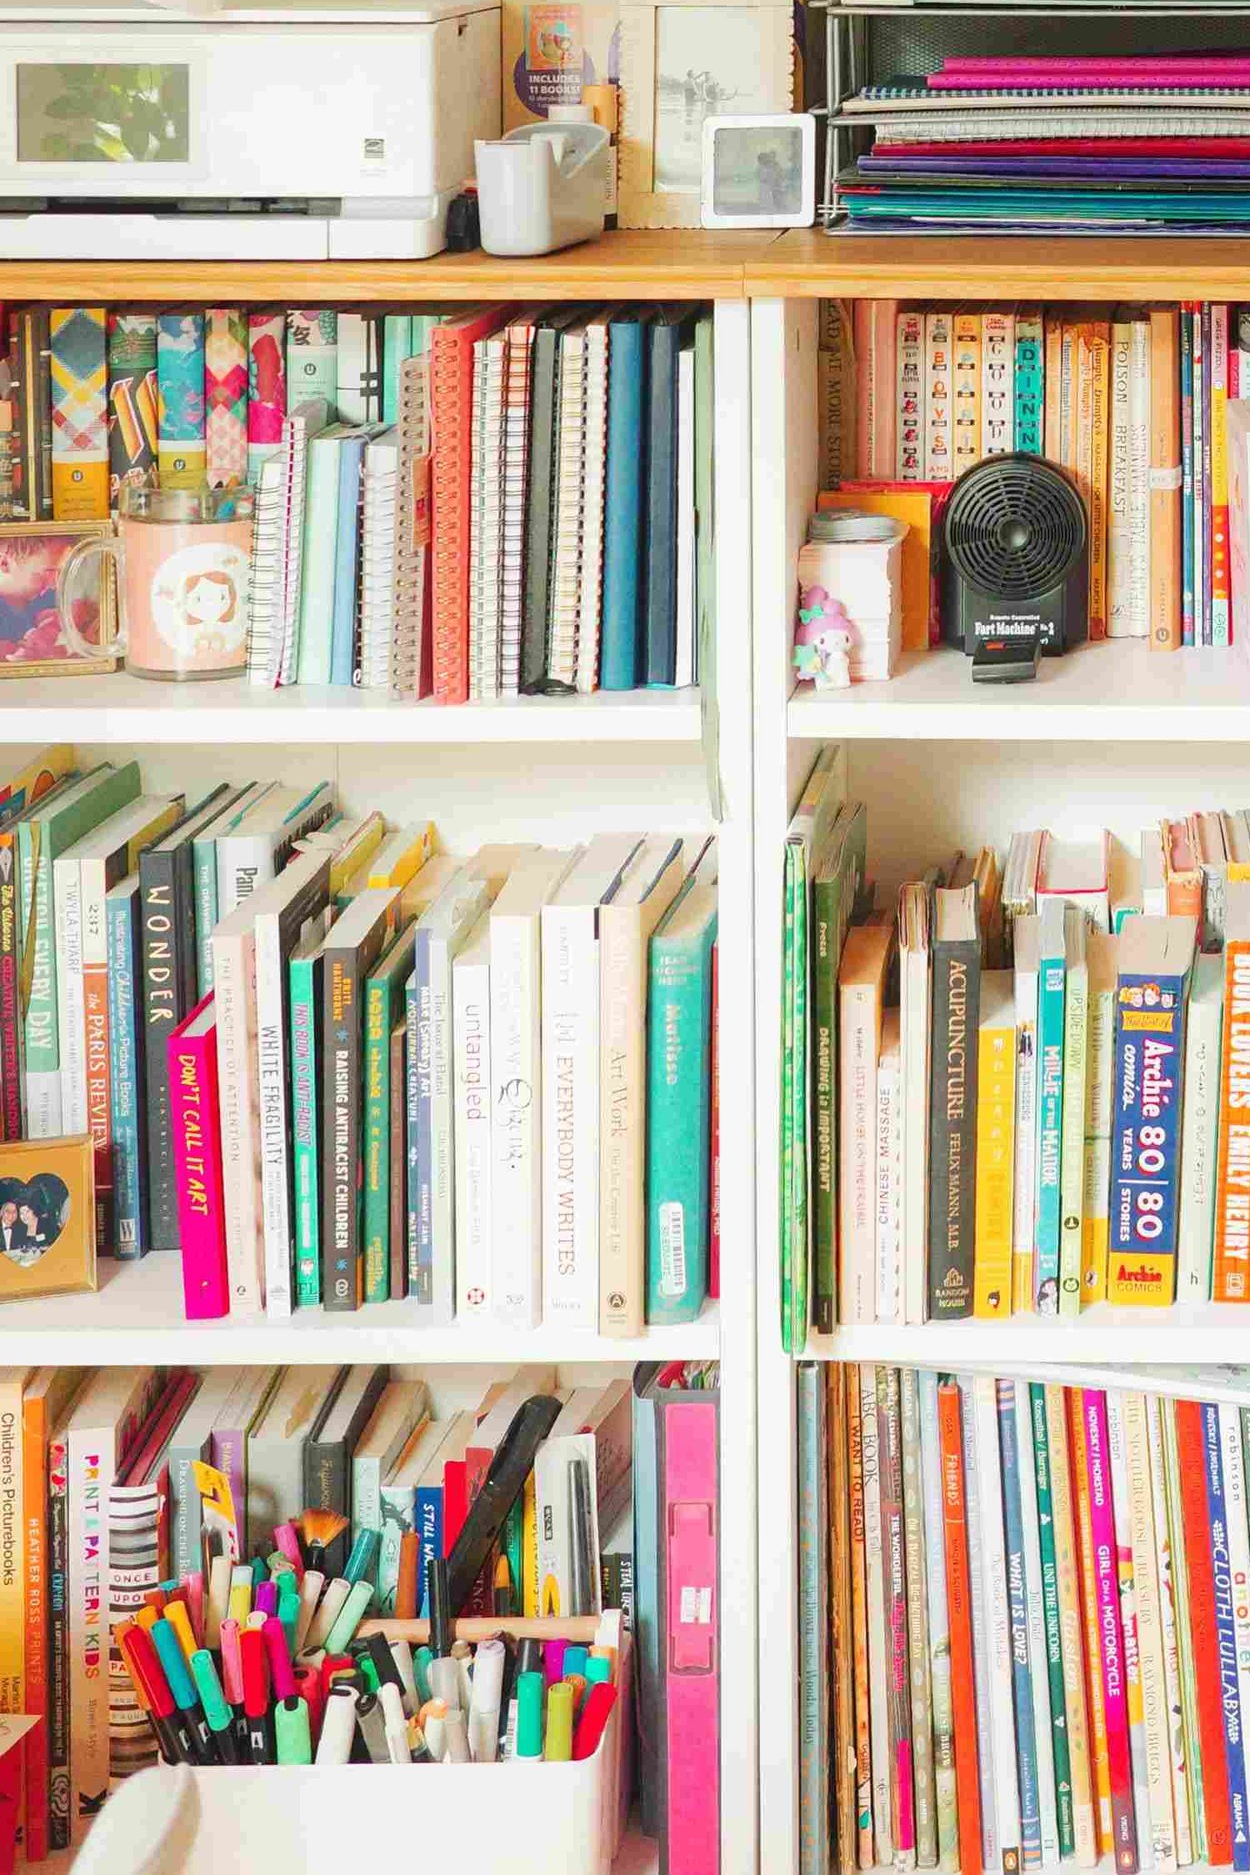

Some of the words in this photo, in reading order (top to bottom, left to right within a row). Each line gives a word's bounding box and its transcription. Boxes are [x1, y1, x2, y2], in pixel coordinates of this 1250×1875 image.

[1116, 341, 1128, 403] POISON
[1113, 425, 1126, 517] BREAKFAST
[975, 622, 996, 635] Fart
[997, 622, 1035, 635] Machine
[147, 886, 174, 1023] WONDER
[28, 1005, 51, 1051] DAY
[89, 1014, 104, 1076] PARIS
[260, 1025, 279, 1079] WHITE
[665, 1004, 682, 1086] Matisse
[946, 958, 968, 1120] ACUPUNCTURE
[178, 1054, 199, 1107] DON'T
[335, 1050, 348, 1102] RAISING
[461, 1004, 488, 1121] untangled
[610, 1049, 628, 1078] Art
[1122, 1044, 1137, 1113] comics
[1140, 1038, 1173, 1121] Archie
[91, 1078, 109, 1153] REVIEW
[181, 1110, 201, 1151] CALL
[262, 1081, 283, 1165] FRAGILITY
[556, 1055, 575, 1185] EVERYBODY
[611, 1079, 628, 1138] Work
[879, 1086, 891, 1158] MASSAGE
[184, 1154, 204, 1179] IT
[334, 1105, 348, 1182] ANTIRACIST
[948, 1133, 961, 1167] FELIX
[1120, 1127, 1134, 1171] YEARS
[1137, 1124, 1165, 1174] 80
[186, 1183, 208, 1216] ART
[335, 1184, 348, 1250] CHILDREN
[879, 1166, 891, 1226] CHINESE
[1119, 1187, 1131, 1242] STORIES
[1136, 1191, 1164, 1240] 80
[557, 1190, 575, 1276] WRITES
[1224, 1194, 1250, 1262] HENRY
[1117, 1282, 1163, 1293] COMICS
[1, 1413, 14, 1486] Children's
[865, 1433, 878, 1487] BOOK
[84, 1454, 100, 1513] PRINT
[946, 1454, 960, 1507] FRIENDS
[2, 1490, 15, 1587] Picturebooks
[29, 1517, 39, 1584] HEATHER
[423, 1503, 436, 1541] STILL
[113, 1571, 152, 1583] ONCE
[1007, 1551, 1024, 1593] WHAT
[1098, 1545, 1111, 1575] GIRL
[29, 1587, 40, 1626] ROSS
[84, 1633, 100, 1680] KIDS
[1011, 1624, 1026, 1664] LOVE?
[1101, 1604, 1120, 1698] MOTORCYCLE
[1122, 1612, 1138, 1685] matter
[1214, 1615, 1239, 1719] LULLABY
